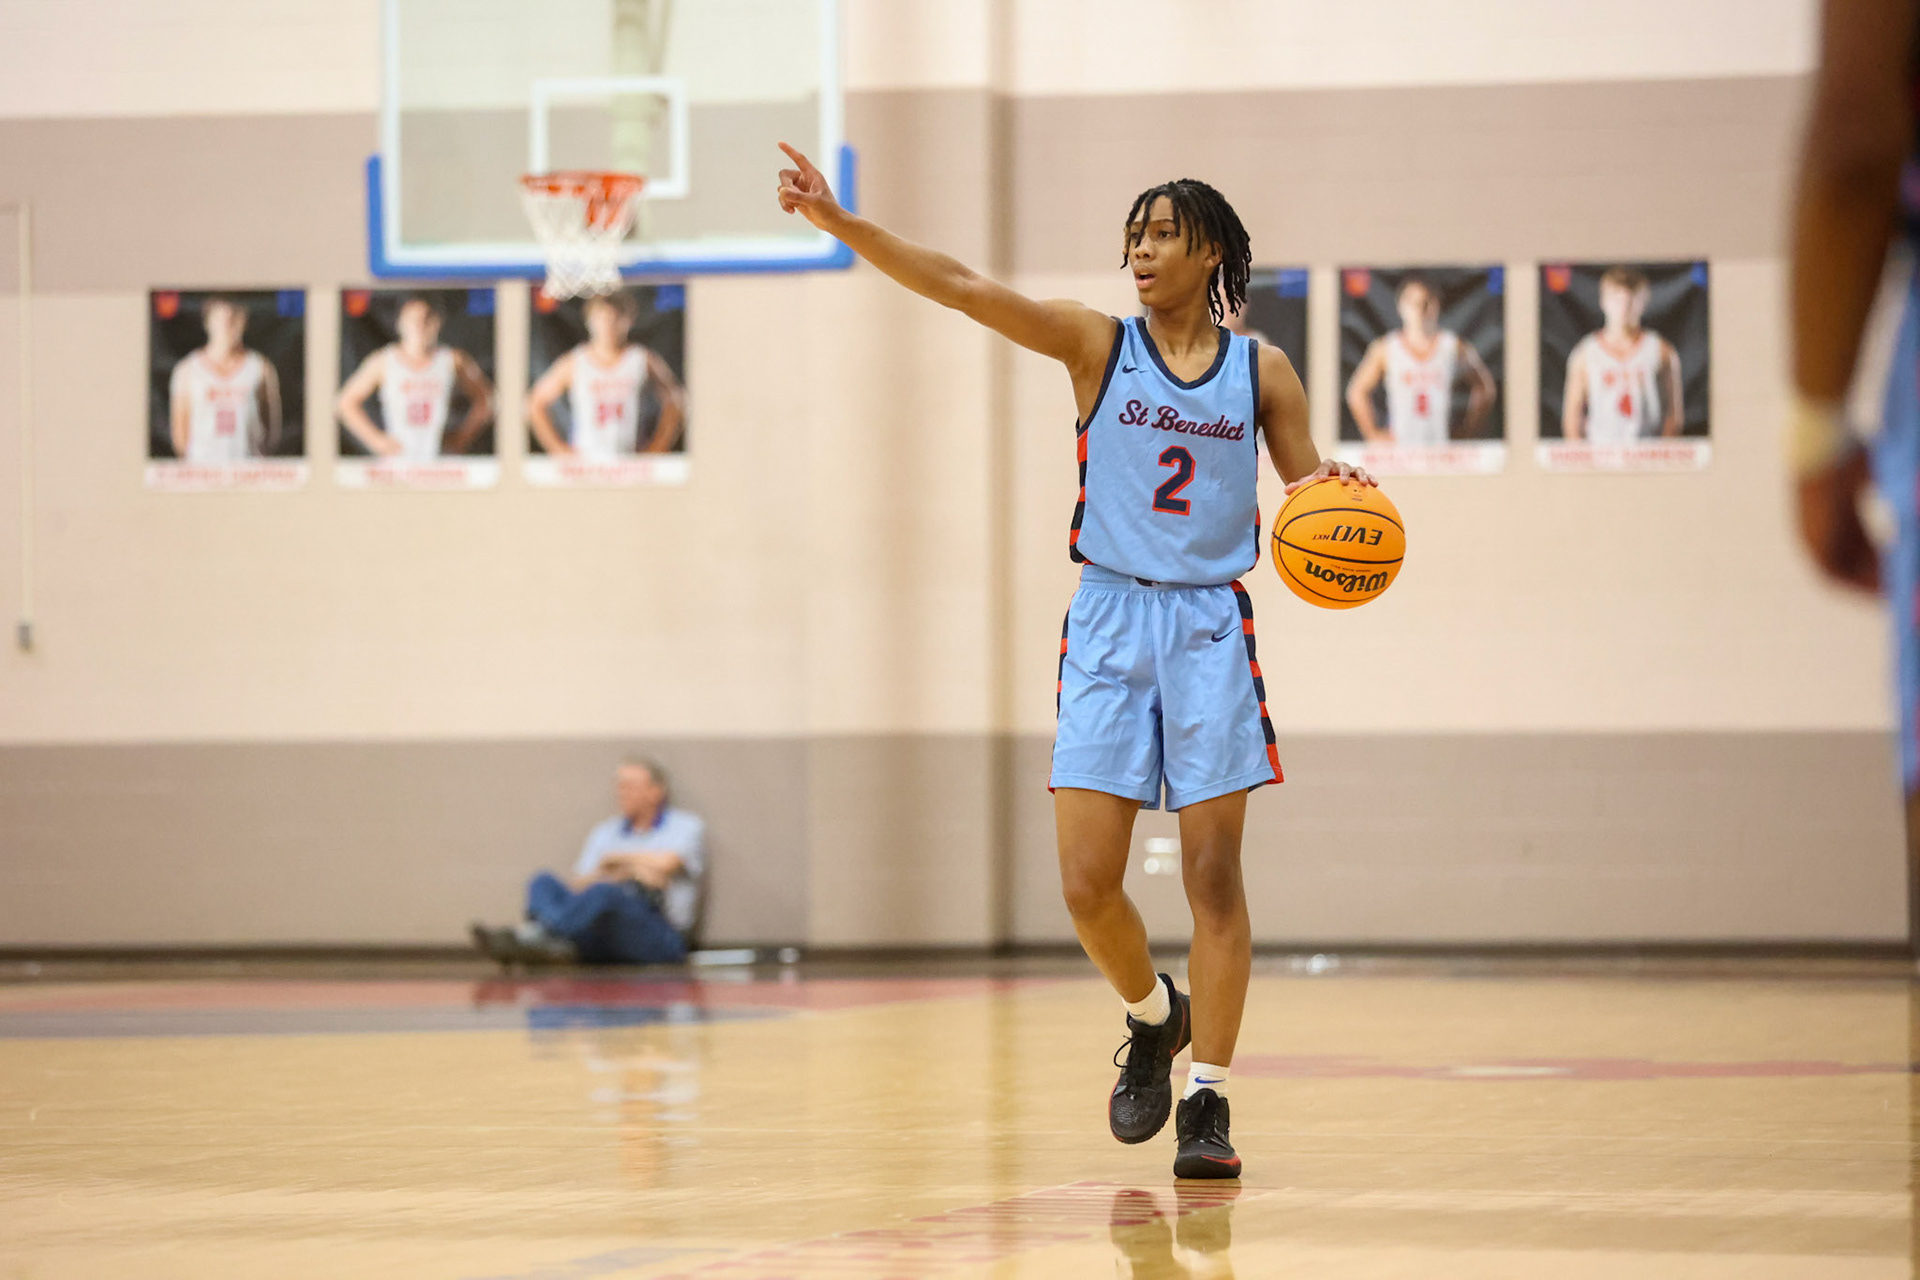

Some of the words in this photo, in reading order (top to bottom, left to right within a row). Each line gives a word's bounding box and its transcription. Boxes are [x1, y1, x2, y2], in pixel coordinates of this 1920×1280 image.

[1119, 399, 1149, 427] St
[1151, 405, 1245, 441] Benedict
[1152, 445, 1196, 517] 2
[1331, 525, 1383, 546] EVO
[1305, 560, 1388, 593] Wilson
